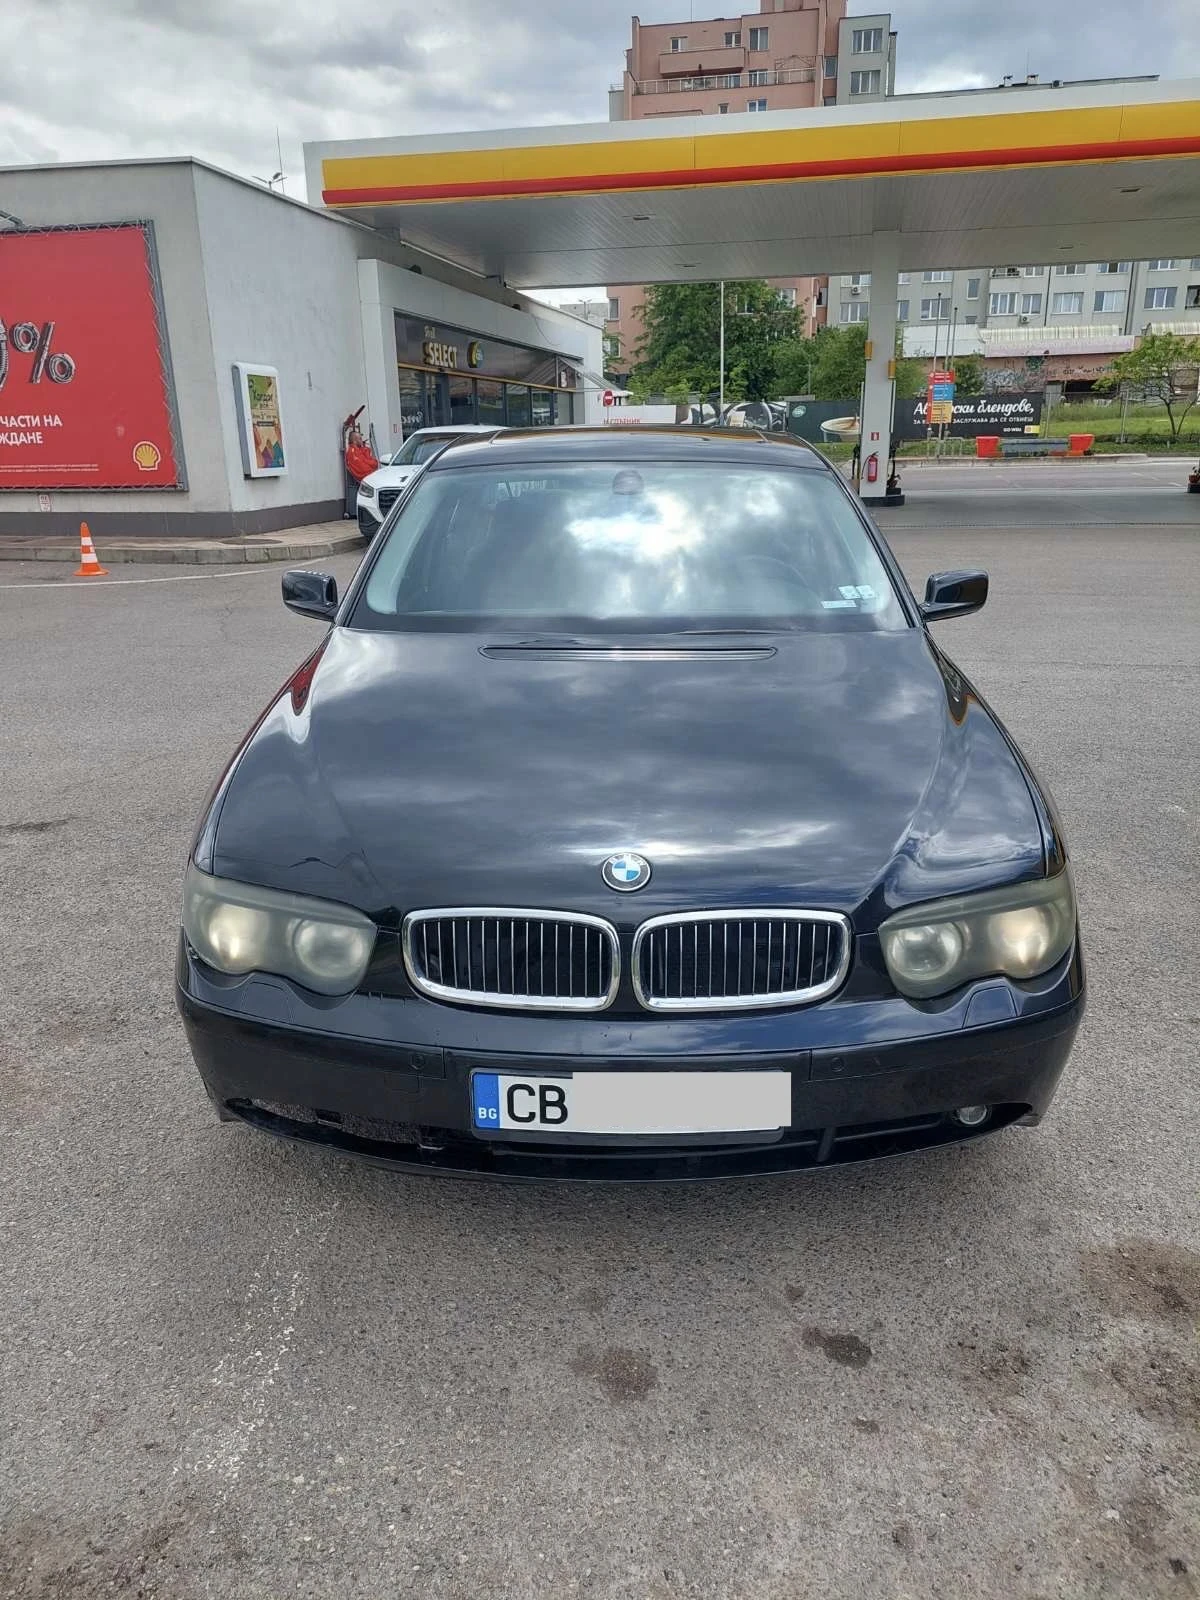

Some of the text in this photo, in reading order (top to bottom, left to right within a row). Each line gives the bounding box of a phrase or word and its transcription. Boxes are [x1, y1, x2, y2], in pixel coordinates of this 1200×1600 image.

[428, 342, 457, 368] SELECT
[43, 414, 63, 427] НА
[478, 1083, 568, 1125] BG CB
